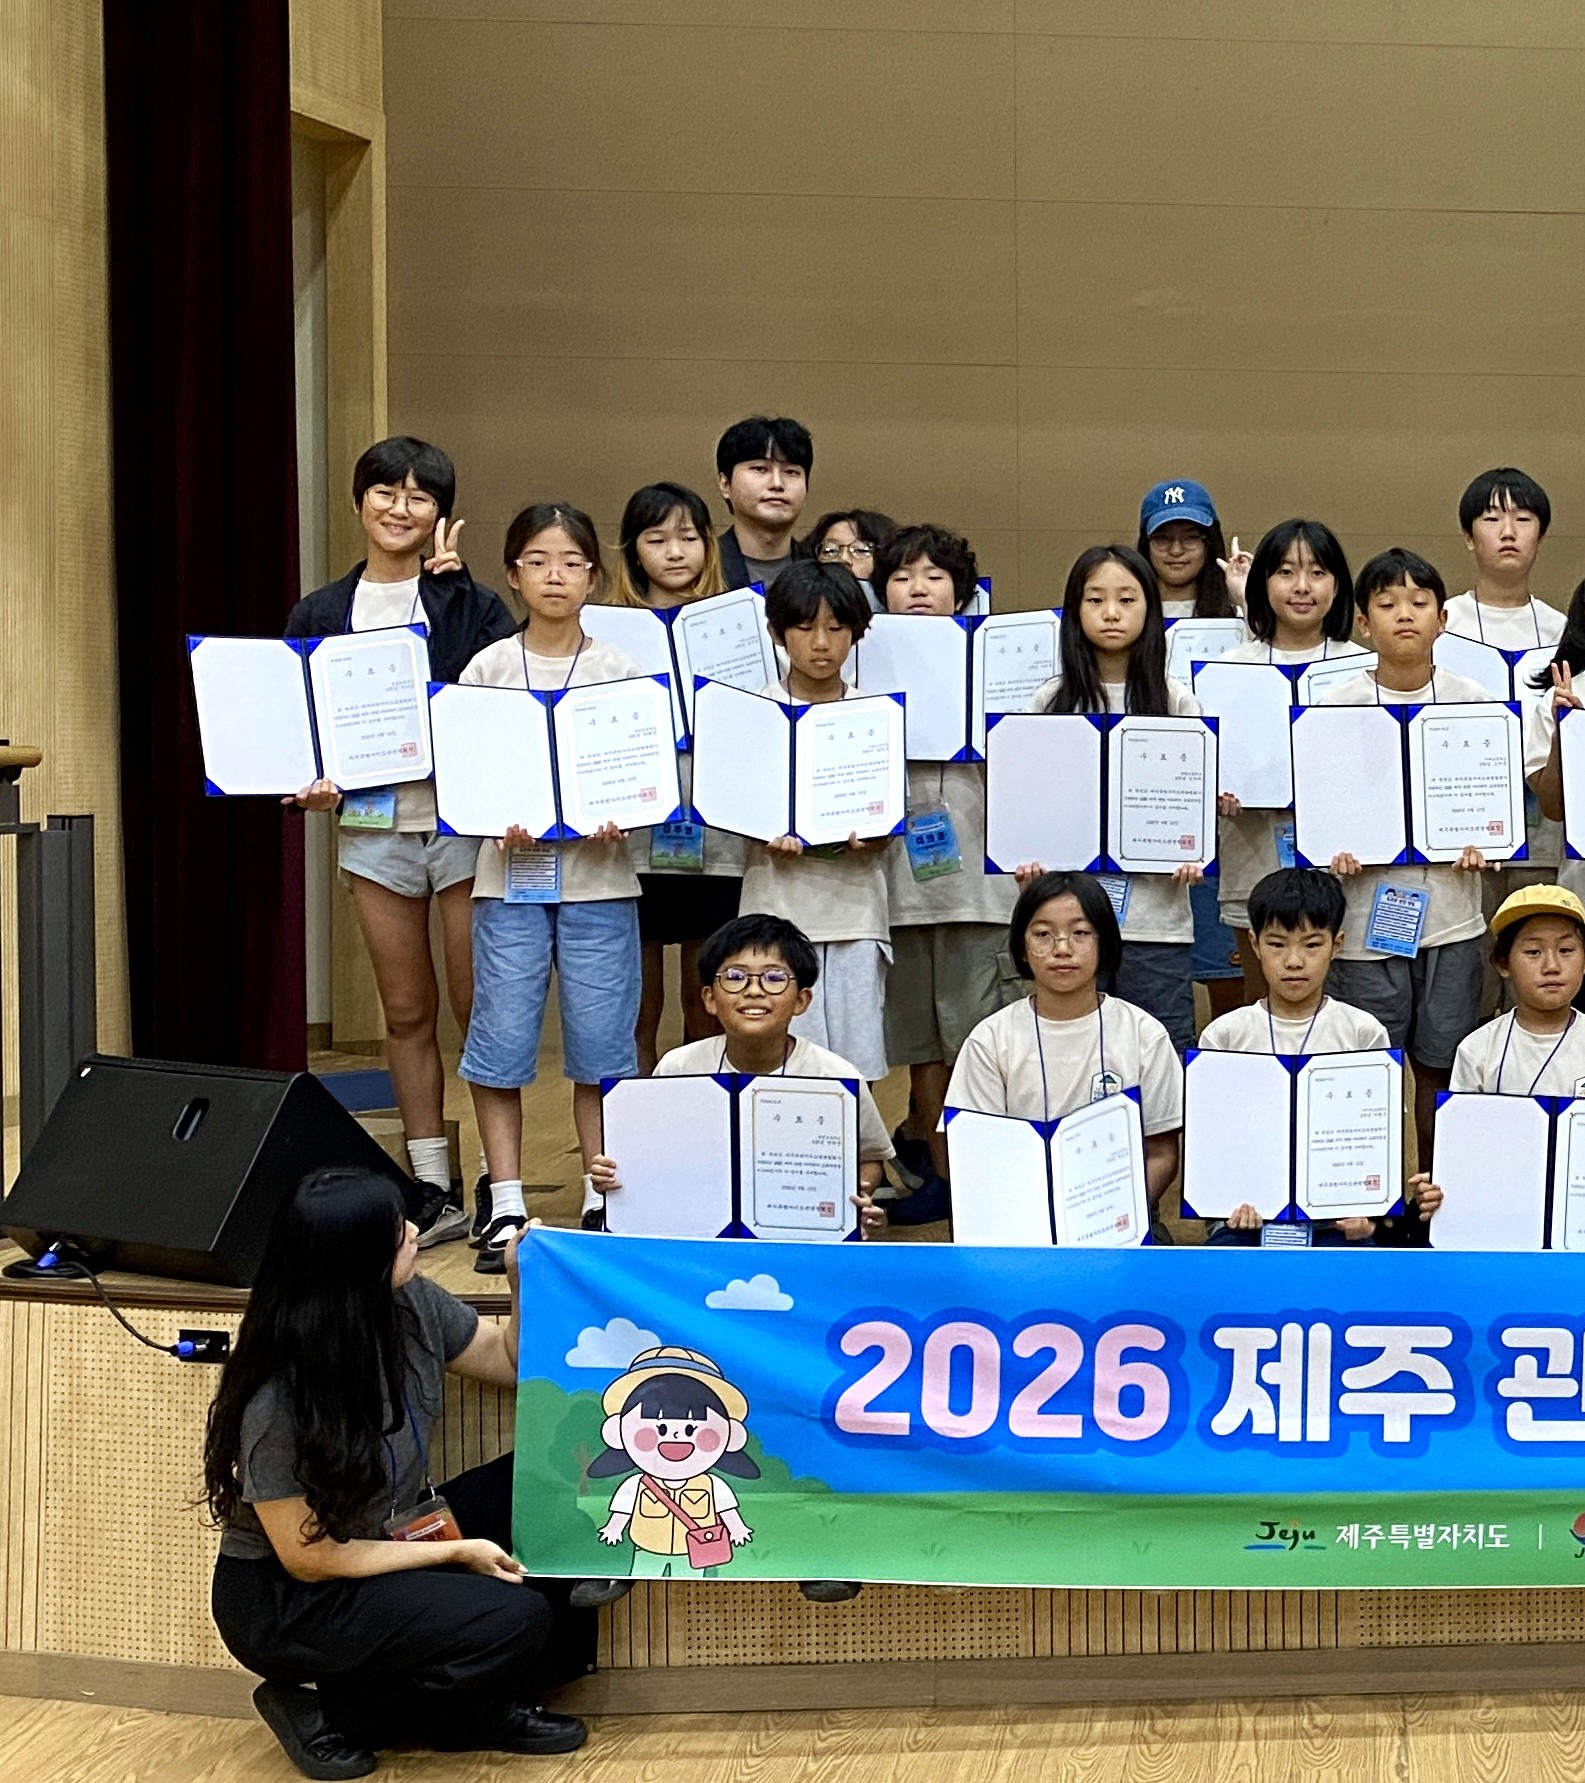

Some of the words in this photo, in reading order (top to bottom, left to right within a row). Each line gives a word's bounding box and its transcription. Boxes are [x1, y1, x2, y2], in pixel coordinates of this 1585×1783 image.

[1164, 486, 1185, 505] NY
[835, 1321, 1170, 1441] 2026
[1211, 1322, 1456, 1443] 제주
[1255, 1519, 1316, 1551] Jeju
[1335, 1523, 1511, 1550] 제주특별자치도
